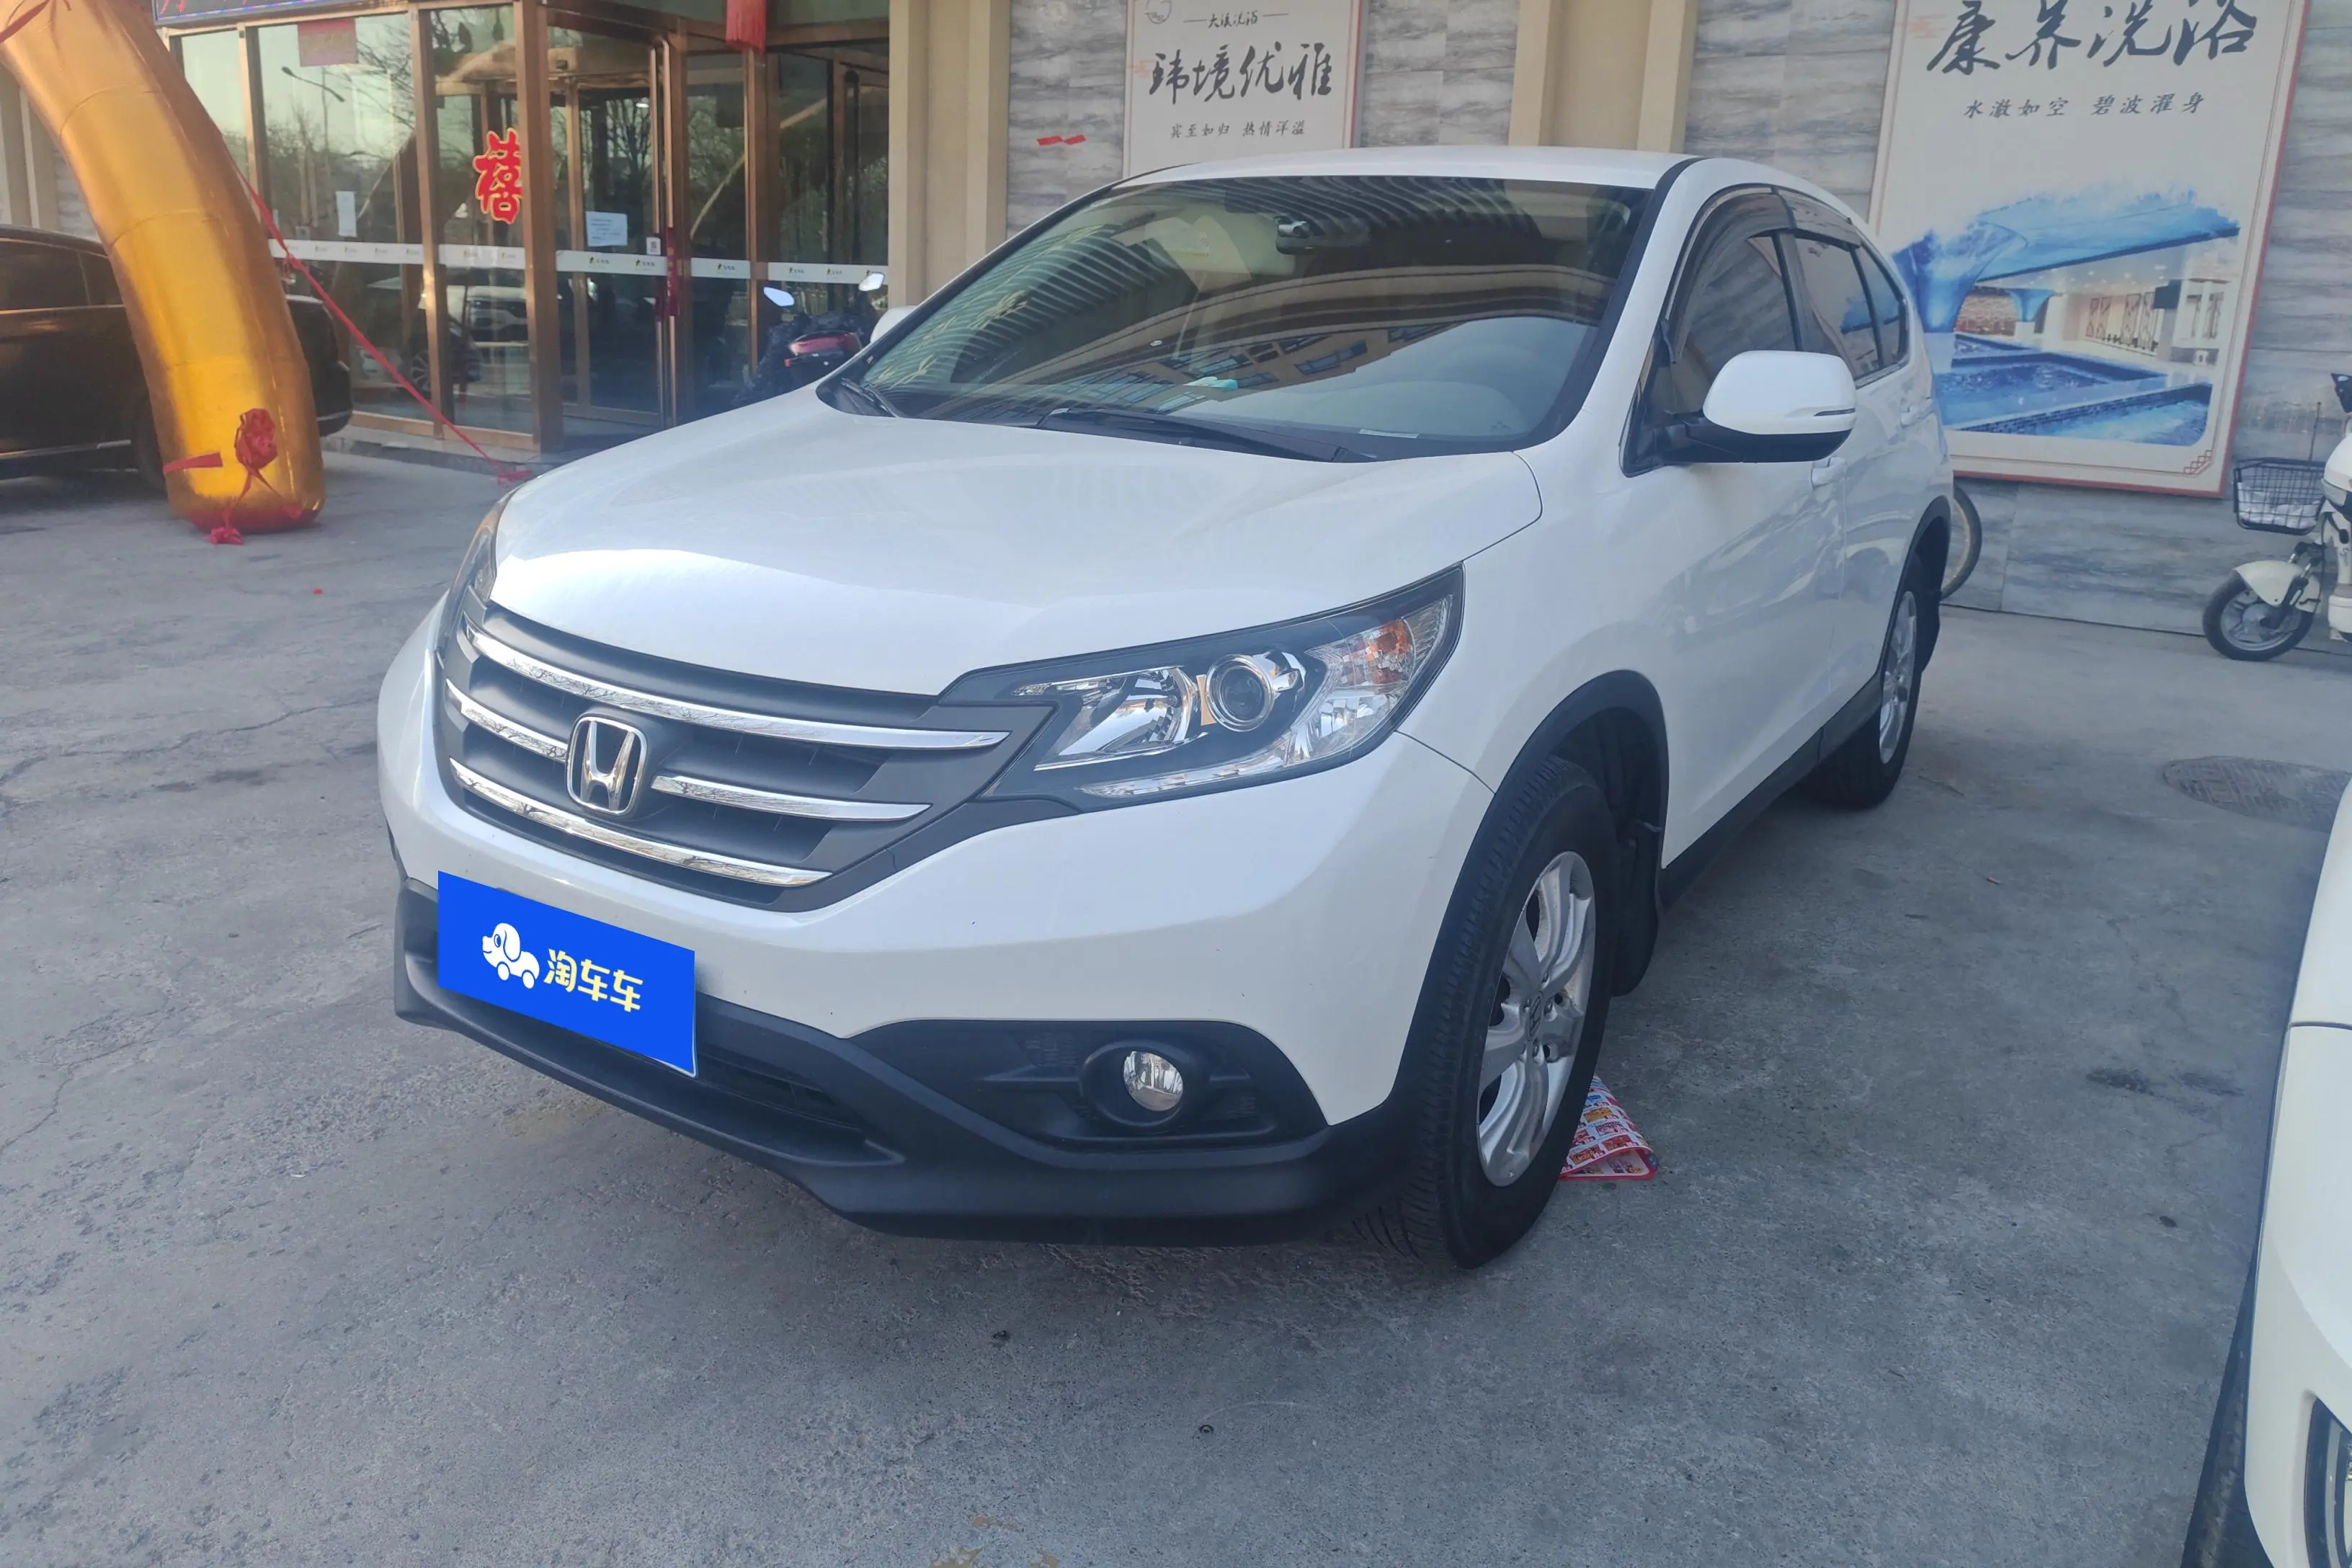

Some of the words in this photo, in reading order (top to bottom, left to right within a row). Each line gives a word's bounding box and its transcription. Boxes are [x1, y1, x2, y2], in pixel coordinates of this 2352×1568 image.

[1170, 122, 1230, 139] 宾至如归
[1243, 120, 1305, 138] 热情洋溢
